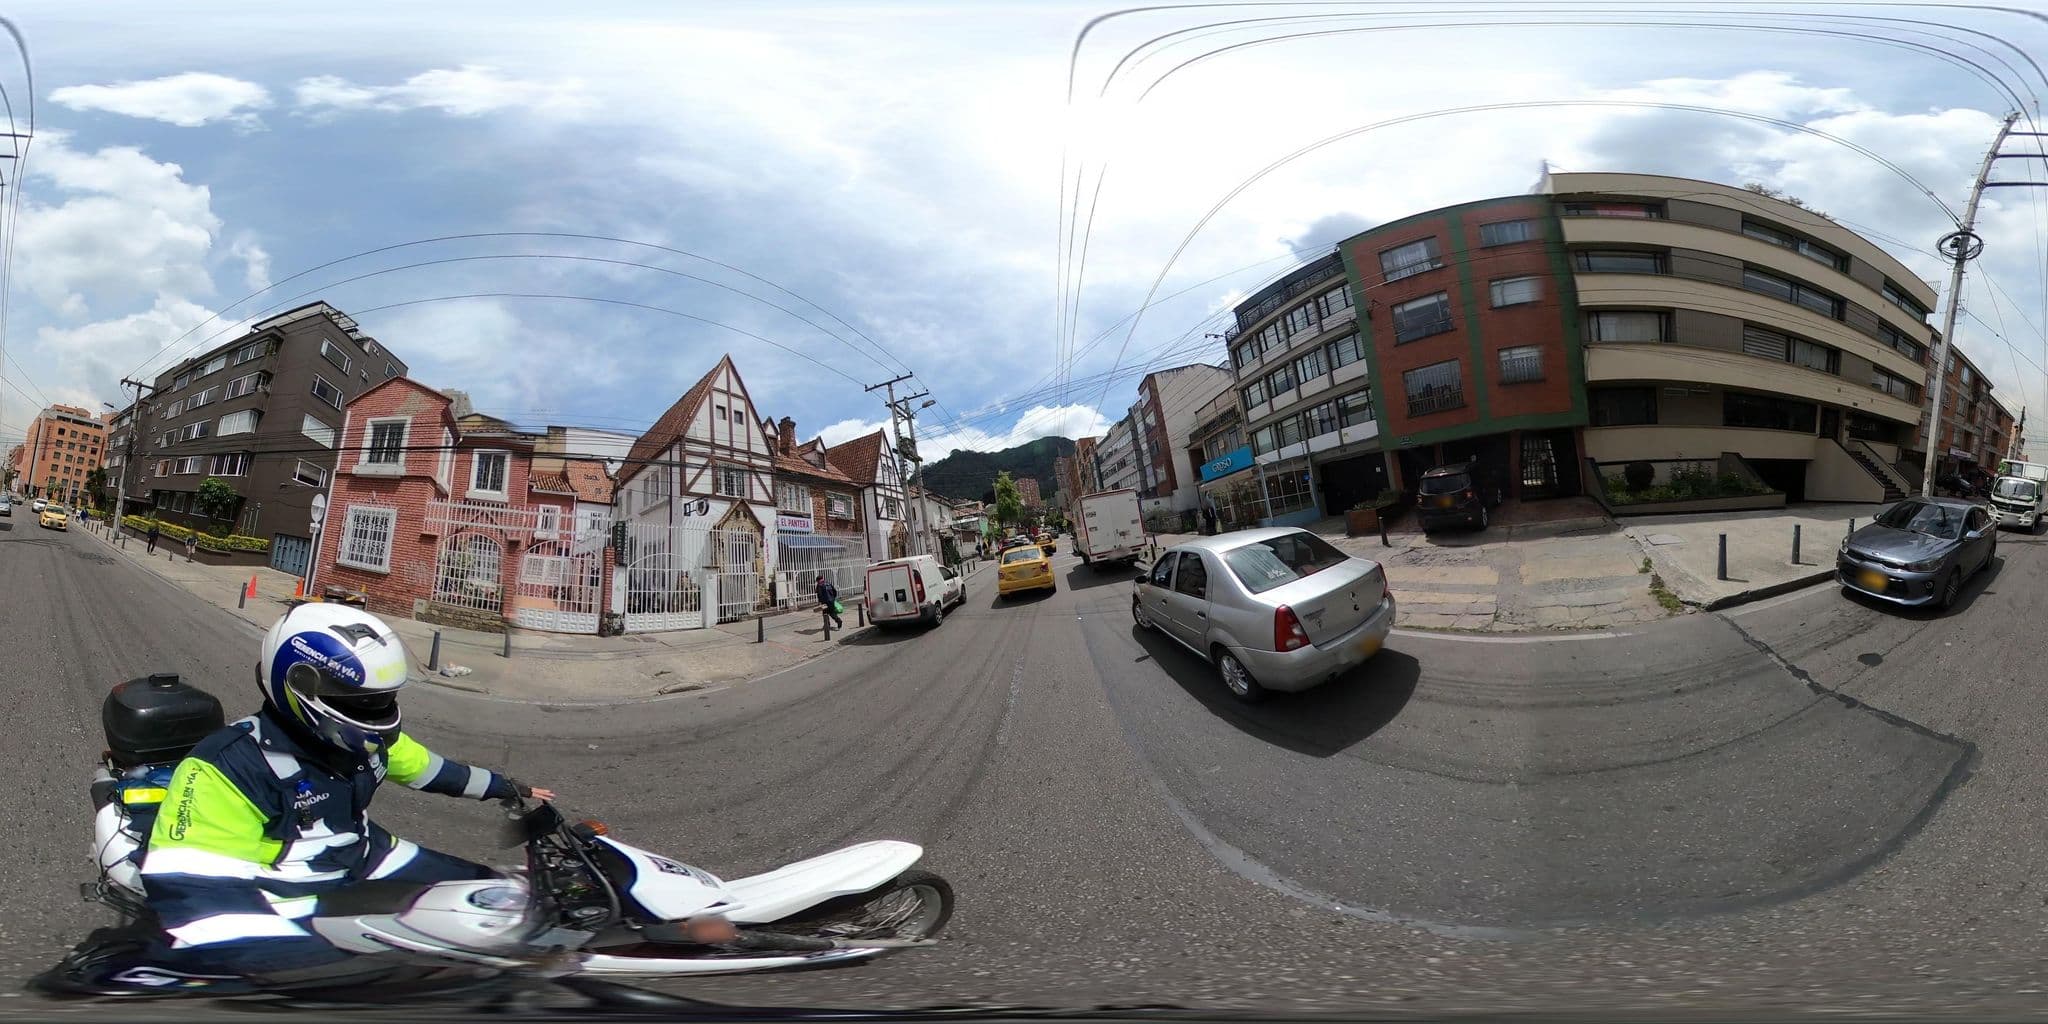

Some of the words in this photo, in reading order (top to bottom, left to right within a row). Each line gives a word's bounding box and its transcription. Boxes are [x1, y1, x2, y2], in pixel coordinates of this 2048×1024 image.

[781, 518, 788, 527] EL
[789, 518, 810, 529] PANTERA
[291, 636, 328, 664] GERENCIA
[327, 659, 342, 672] EN
[341, 664, 358, 679] VÍA
[186, 772, 199, 785] VÍA
[183, 786, 190, 799] EN
[169, 800, 188, 841] GERENCIA
